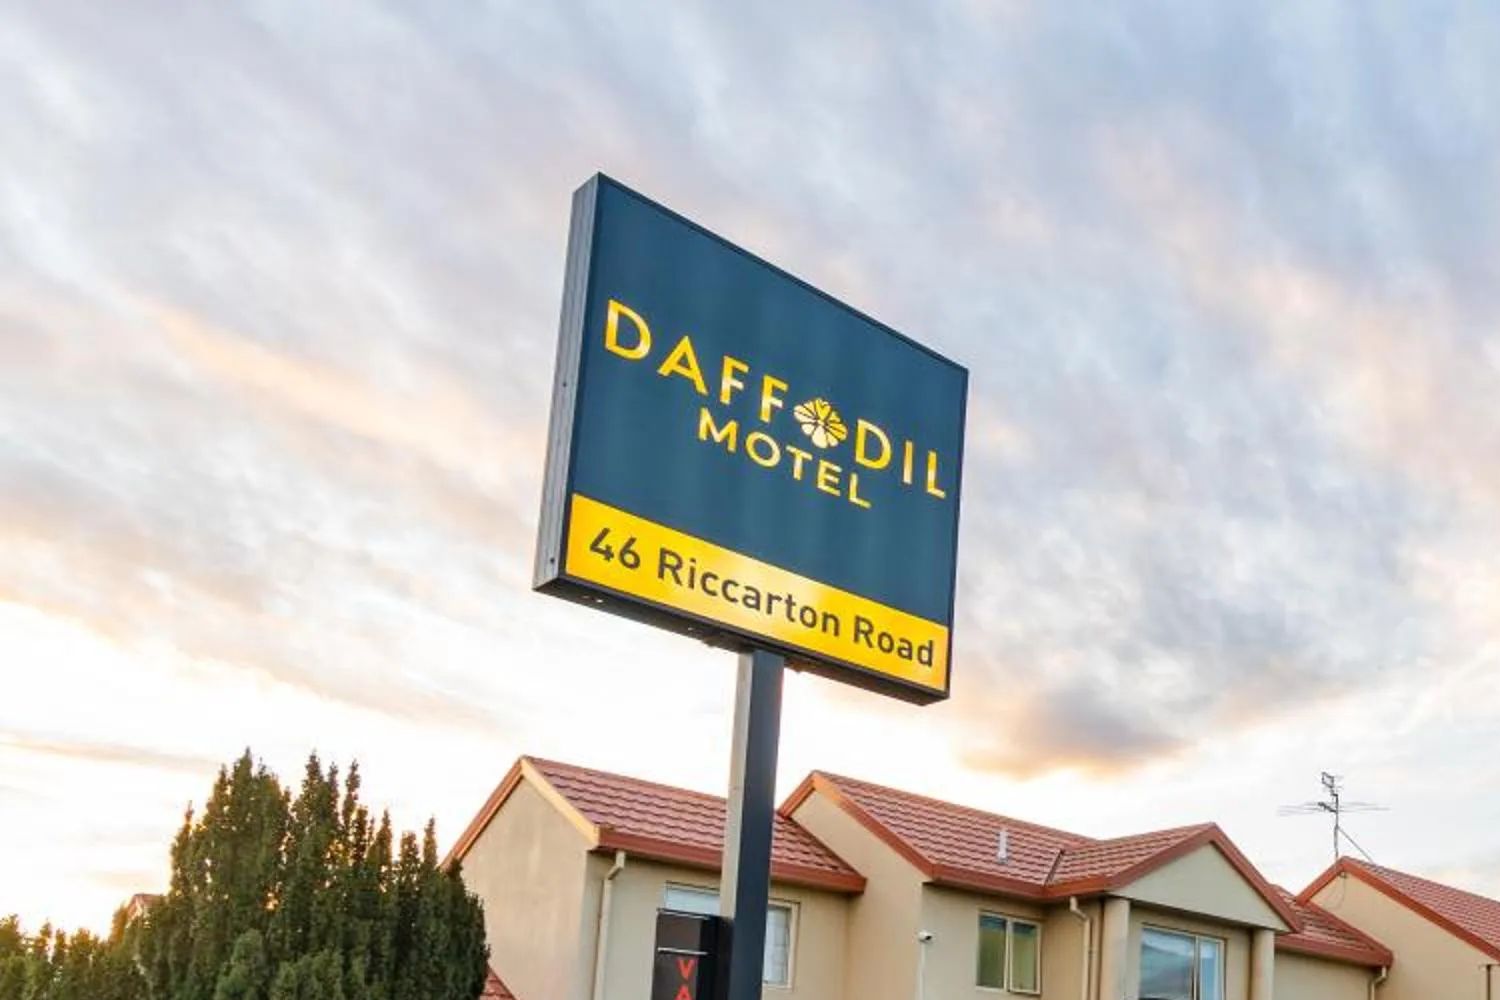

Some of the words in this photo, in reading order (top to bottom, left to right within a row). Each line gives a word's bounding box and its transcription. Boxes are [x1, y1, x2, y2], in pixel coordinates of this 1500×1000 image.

[699, 406, 871, 509] MOTEL
[589, 527, 641, 570] 46
[657, 547, 841, 637] Riccarton
[853, 615, 934, 667] Road
